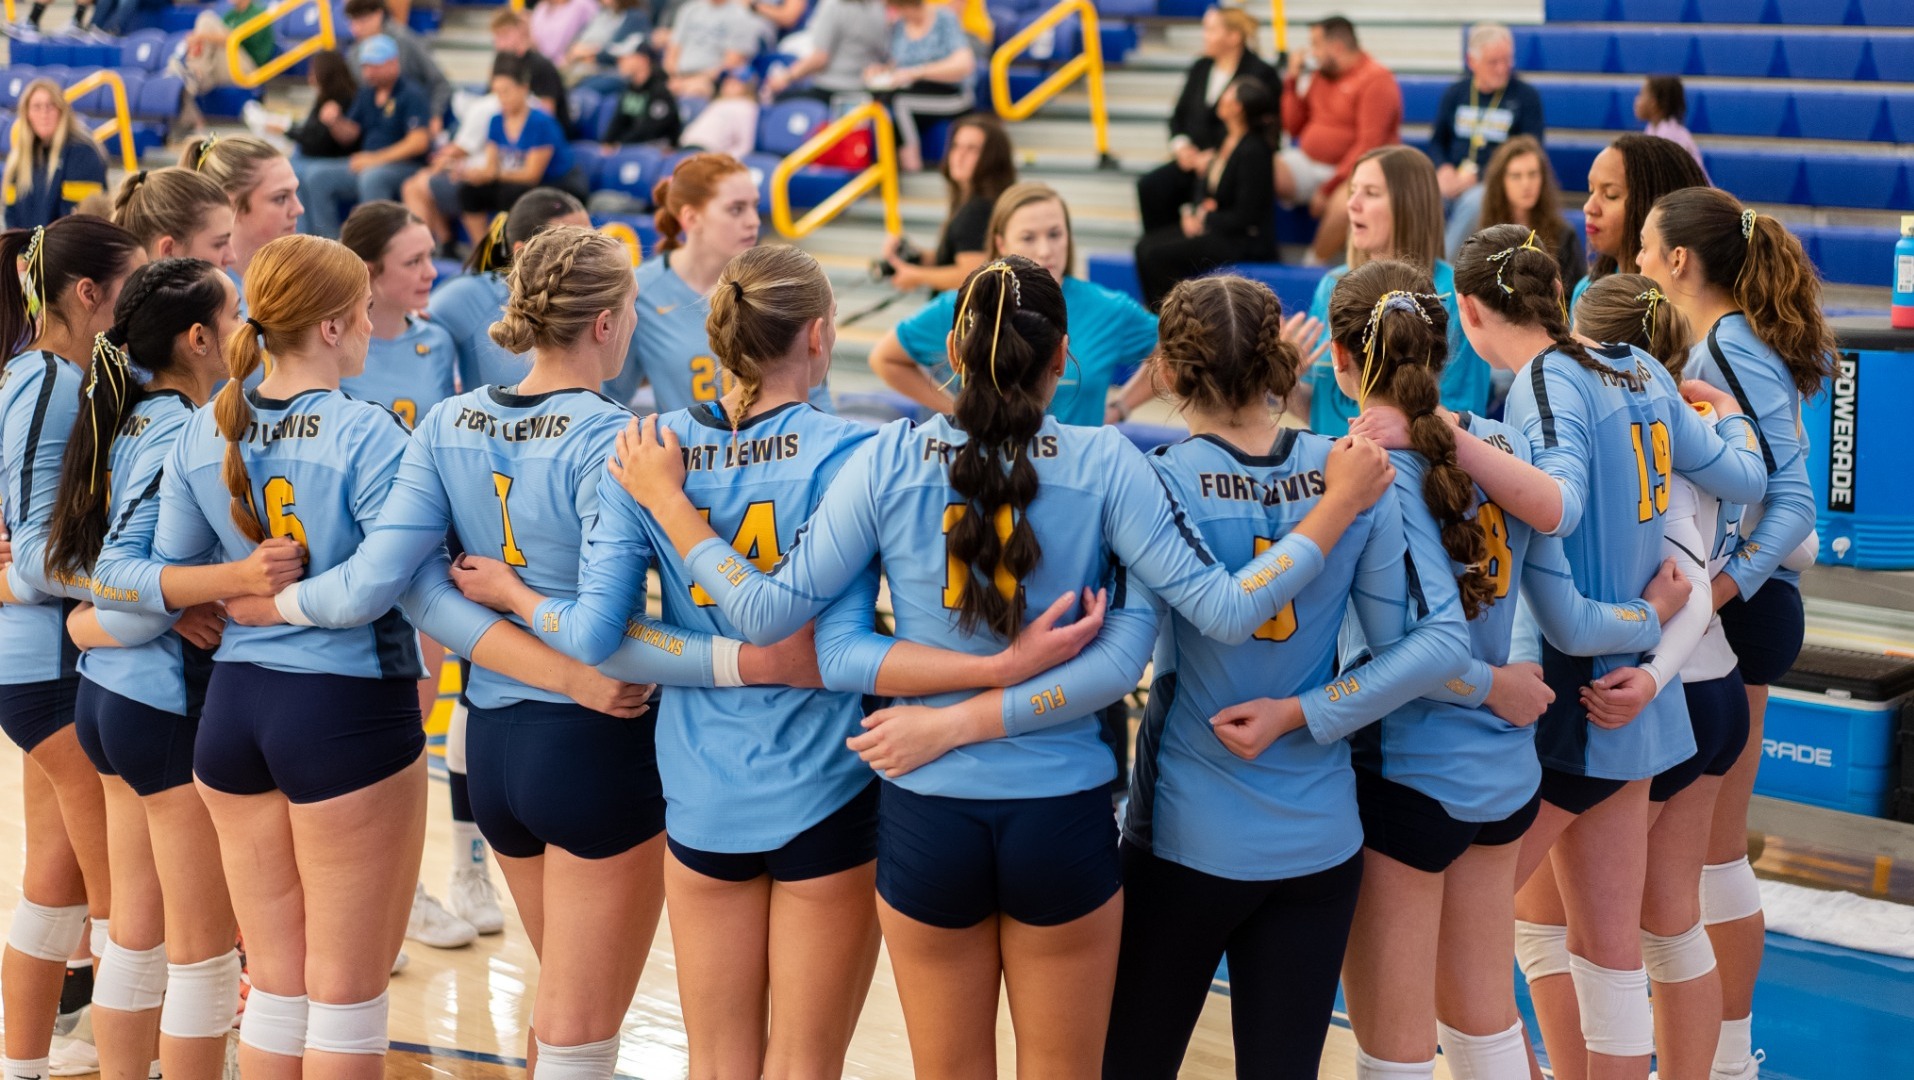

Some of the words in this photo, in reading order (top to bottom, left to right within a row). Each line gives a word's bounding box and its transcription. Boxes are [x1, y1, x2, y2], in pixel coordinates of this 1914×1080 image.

[454, 407, 499, 438] FORT
[502, 414, 571, 442] LEWIS
[1830, 360, 1857, 505] POWERADE
[679, 445, 718, 471] ORT
[724, 433, 799, 469] LEWIS
[1199, 473, 1259, 501] FORT
[1630, 418, 1672, 524] 19
[243, 475, 311, 566] 6
[492, 470, 528, 568] 1
[717, 556, 749, 588] FLC
[1030, 684, 1067, 716] FLC
[1324, 676, 1361, 702] FLC
[1761, 738, 1832, 768] RADE
